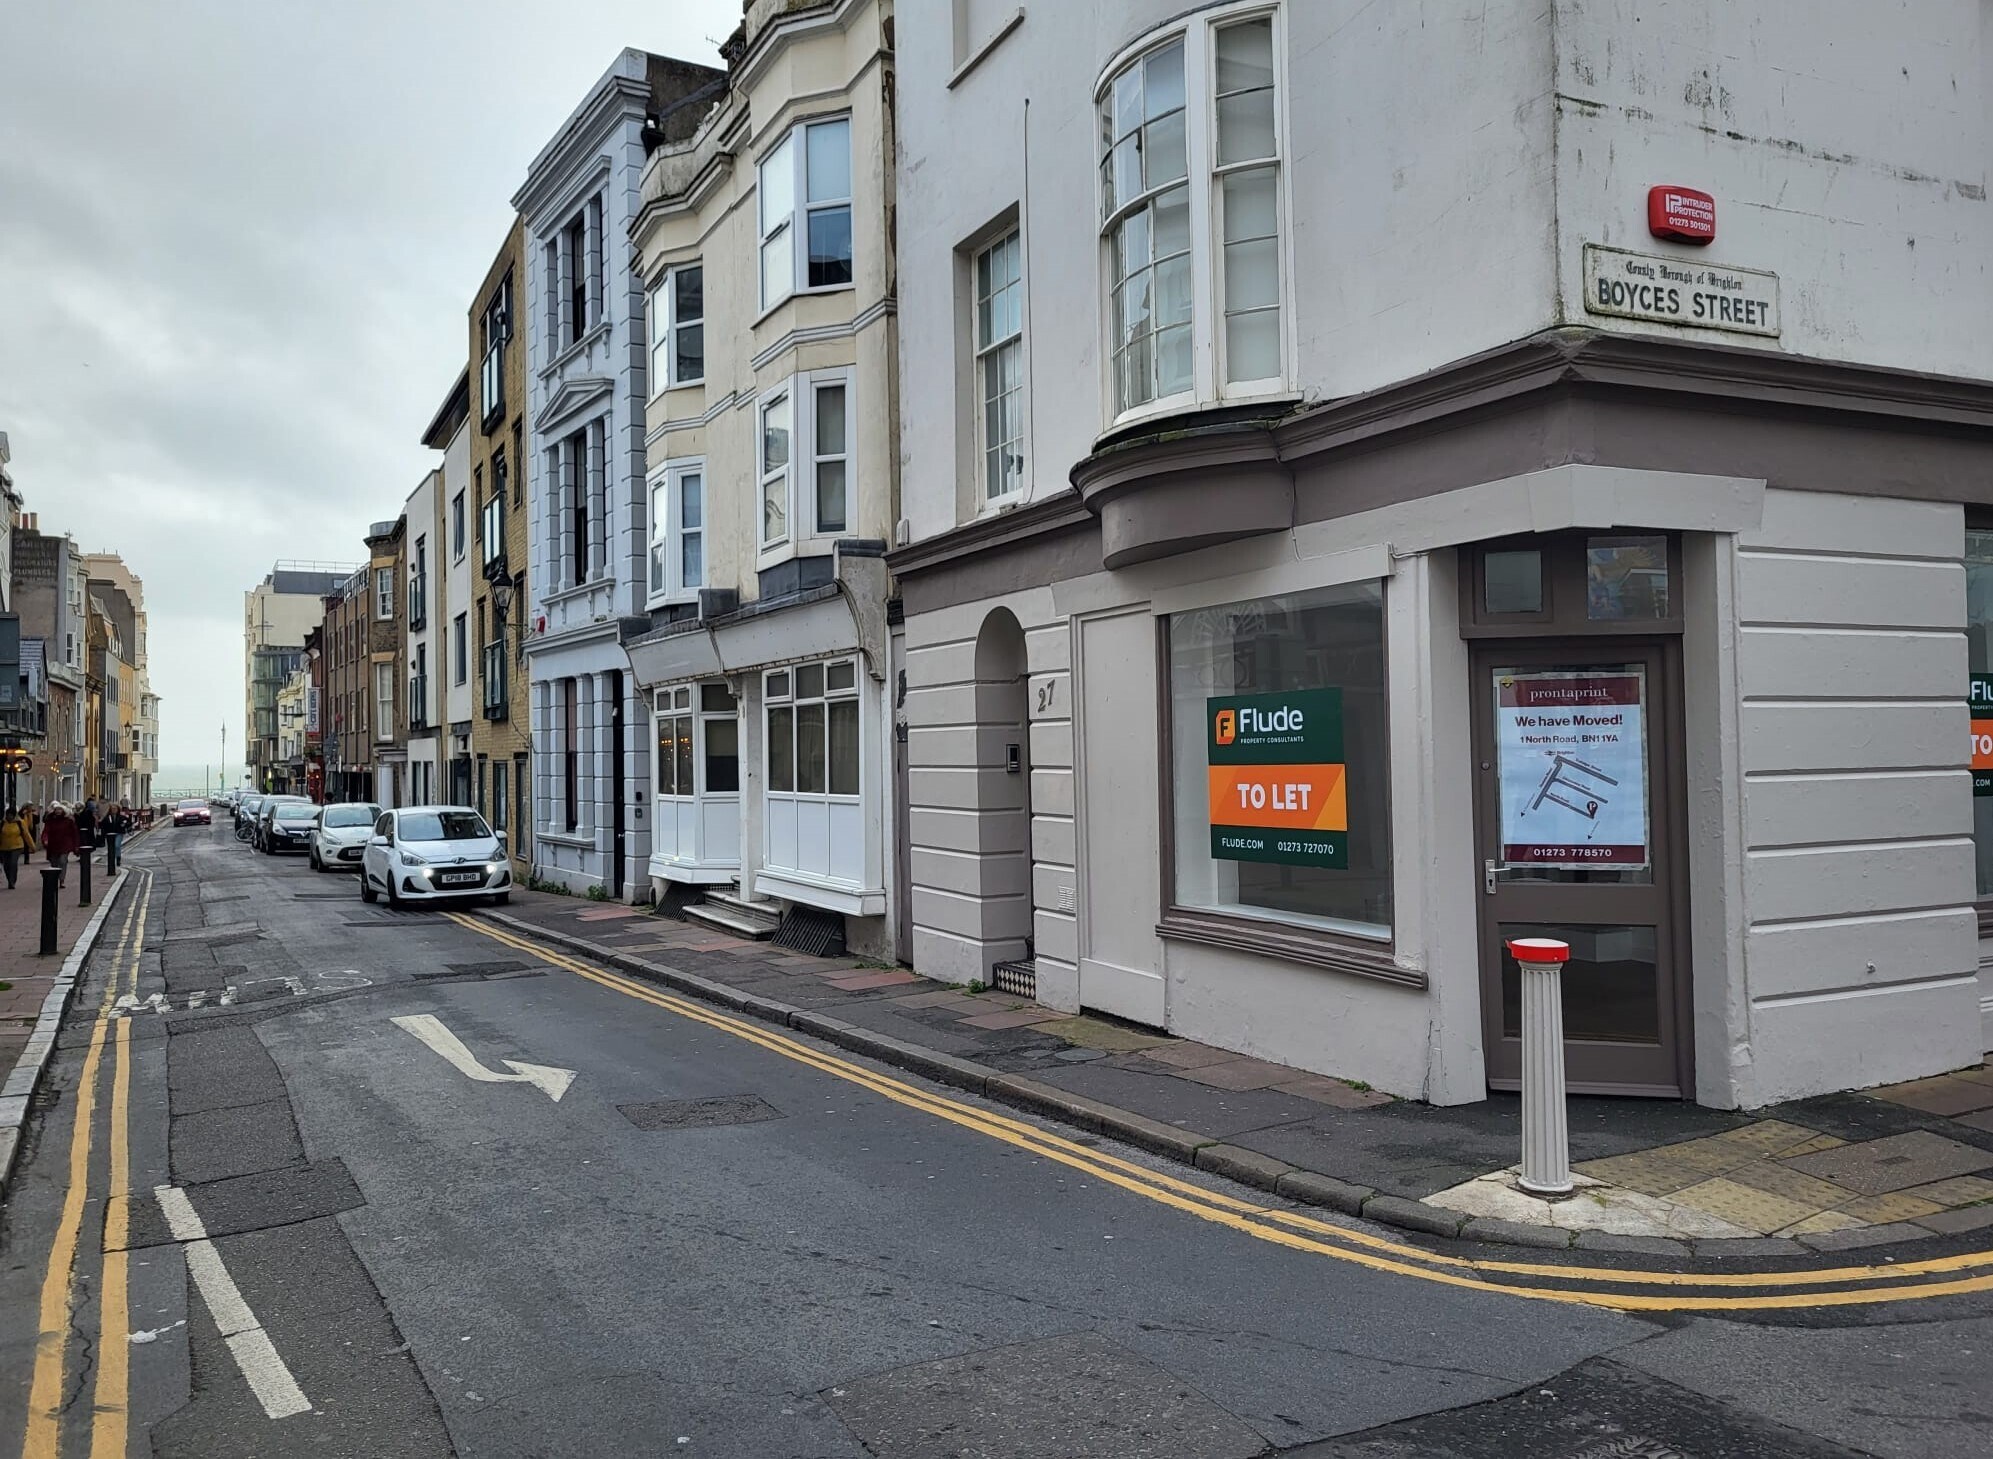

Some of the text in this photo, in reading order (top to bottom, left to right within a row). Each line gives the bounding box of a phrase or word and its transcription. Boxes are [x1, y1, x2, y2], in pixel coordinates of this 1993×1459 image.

[1682, 197, 1713, 212] INTRUDER
[1669, 216, 1689, 228] 01273
[1674, 206, 1714, 222] PROTECTION
[1626, 260, 1742, 291] County Borough of Brighton
[1598, 278, 1769, 327] BOYCES STREET
[1037, 679, 1056, 713] 27
[1530, 686, 1609, 702] prontaprint
[1239, 706, 1304, 733] Flude
[1515, 714, 1624, 728] We have Moved!
[1266, 735, 1304, 744] CONSULTANTS
[1525, 735, 1552, 744] North
[1552, 735, 1580, 744] Road,
[1236, 783, 1312, 810] TO LET
[1221, 837, 1334, 855] FLUDE.COM 01273 727070
[1533, 848, 1612, 857] 01273 778570
